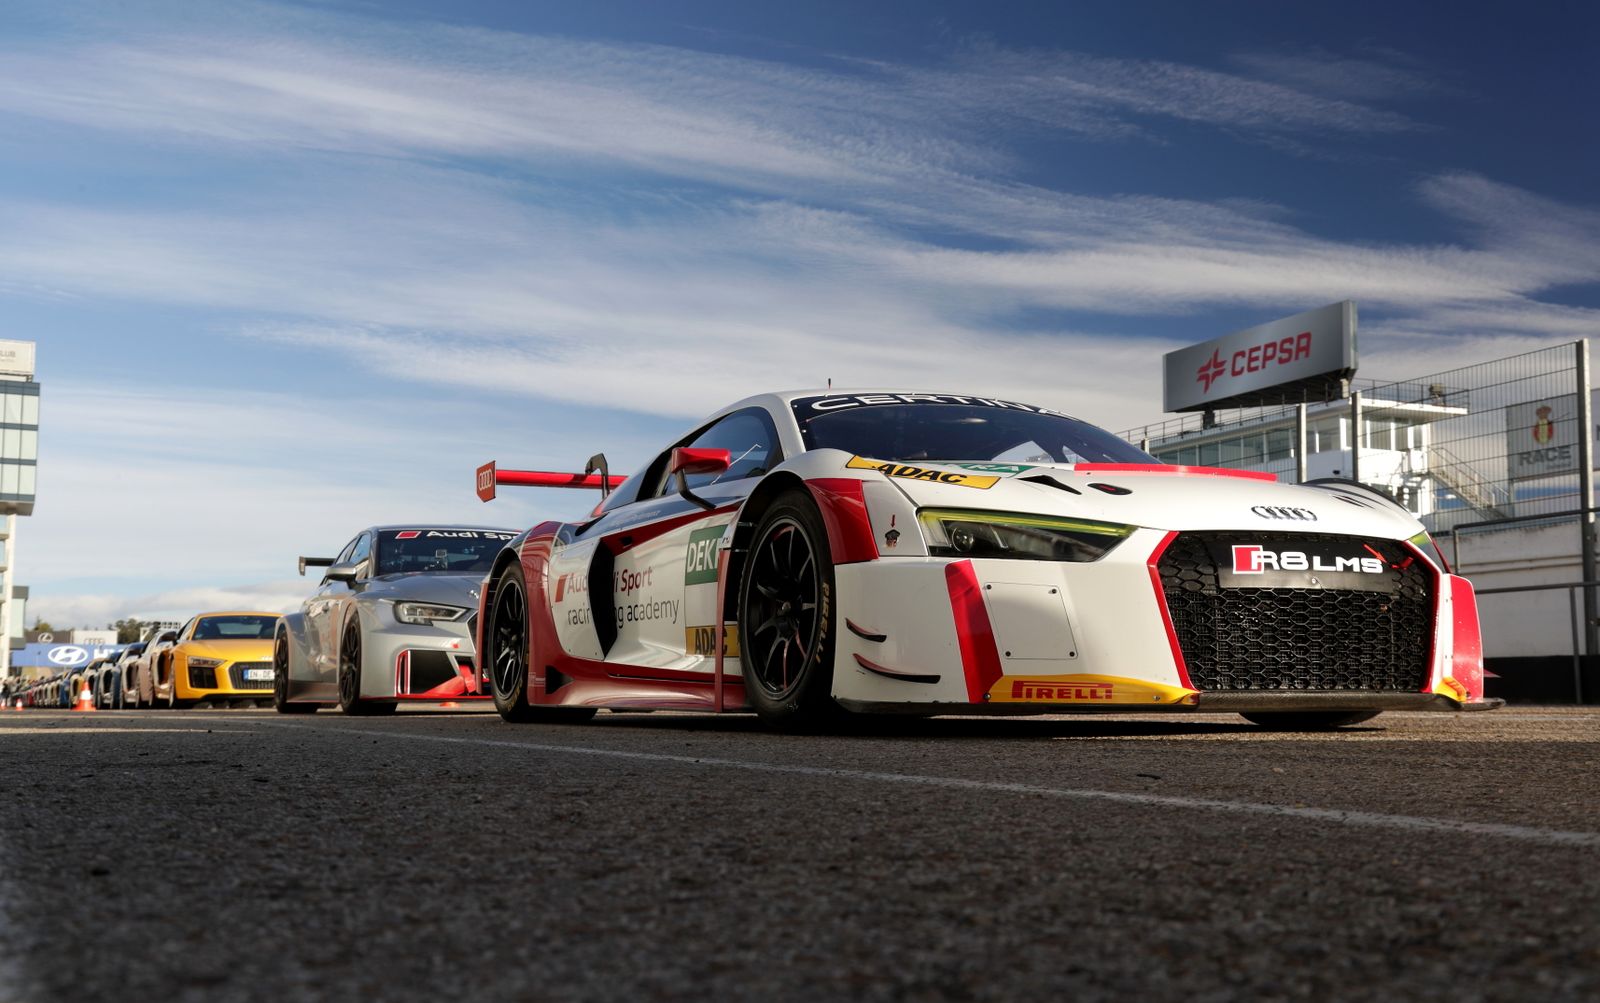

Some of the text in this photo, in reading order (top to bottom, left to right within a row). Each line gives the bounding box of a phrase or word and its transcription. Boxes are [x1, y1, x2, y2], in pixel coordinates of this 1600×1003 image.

[1231, 331, 1312, 377] CEPSA
[1519, 446, 1571, 466] RACE
[877, 463, 968, 483] ADAC
[426, 531, 479, 539] Audi
[1250, 550, 1384, 574] R8 LMS
[620, 565, 653, 596] Sport
[626, 597, 680, 624] academy
[1011, 680, 1114, 700] PIRELLI
